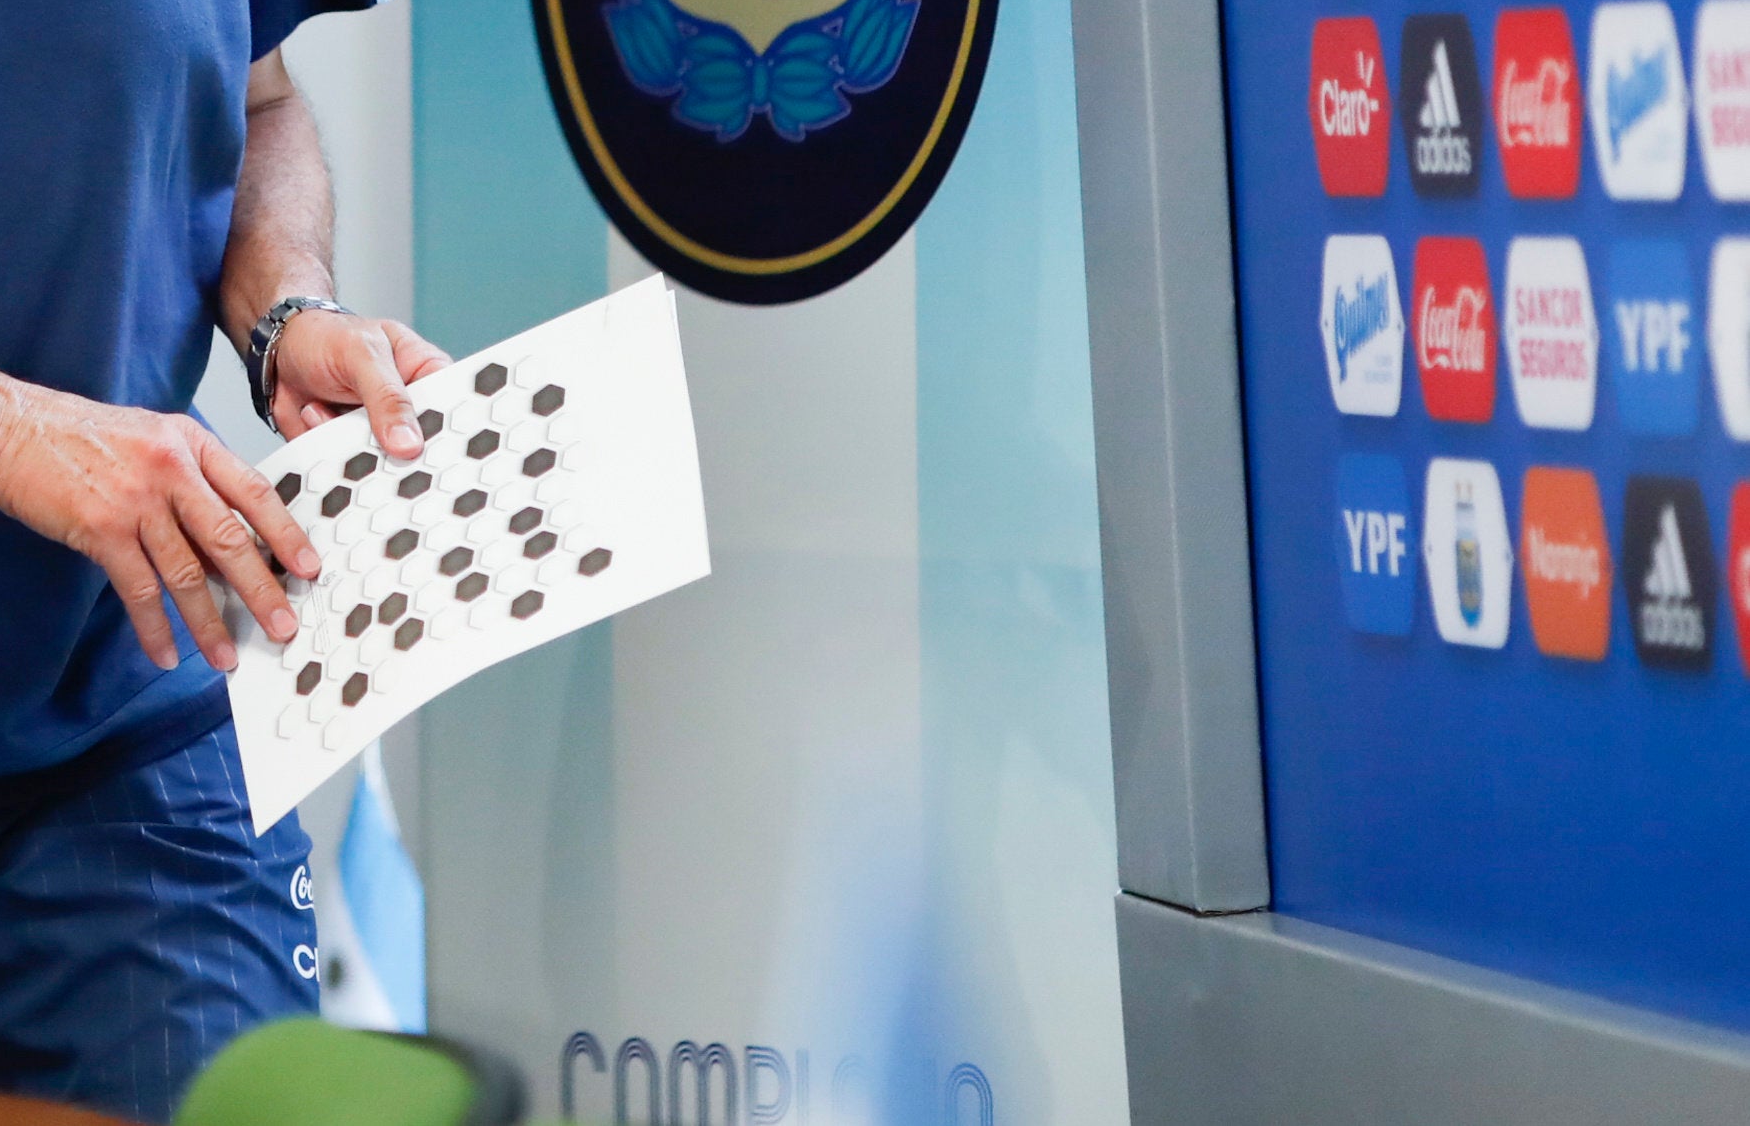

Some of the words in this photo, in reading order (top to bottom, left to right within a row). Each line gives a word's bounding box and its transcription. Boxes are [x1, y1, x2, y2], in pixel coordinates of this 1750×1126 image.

[1320, 79, 1371, 137] Claro
[1416, 134, 1471, 175] adidas
[1421, 286, 1487, 372] Coca-Cola
[1515, 286, 1583, 326] SANCOR
[1519, 338, 1589, 381] SEGUROS
[1616, 302, 1690, 373] YPF
[1344, 508, 1406, 578] YPF
